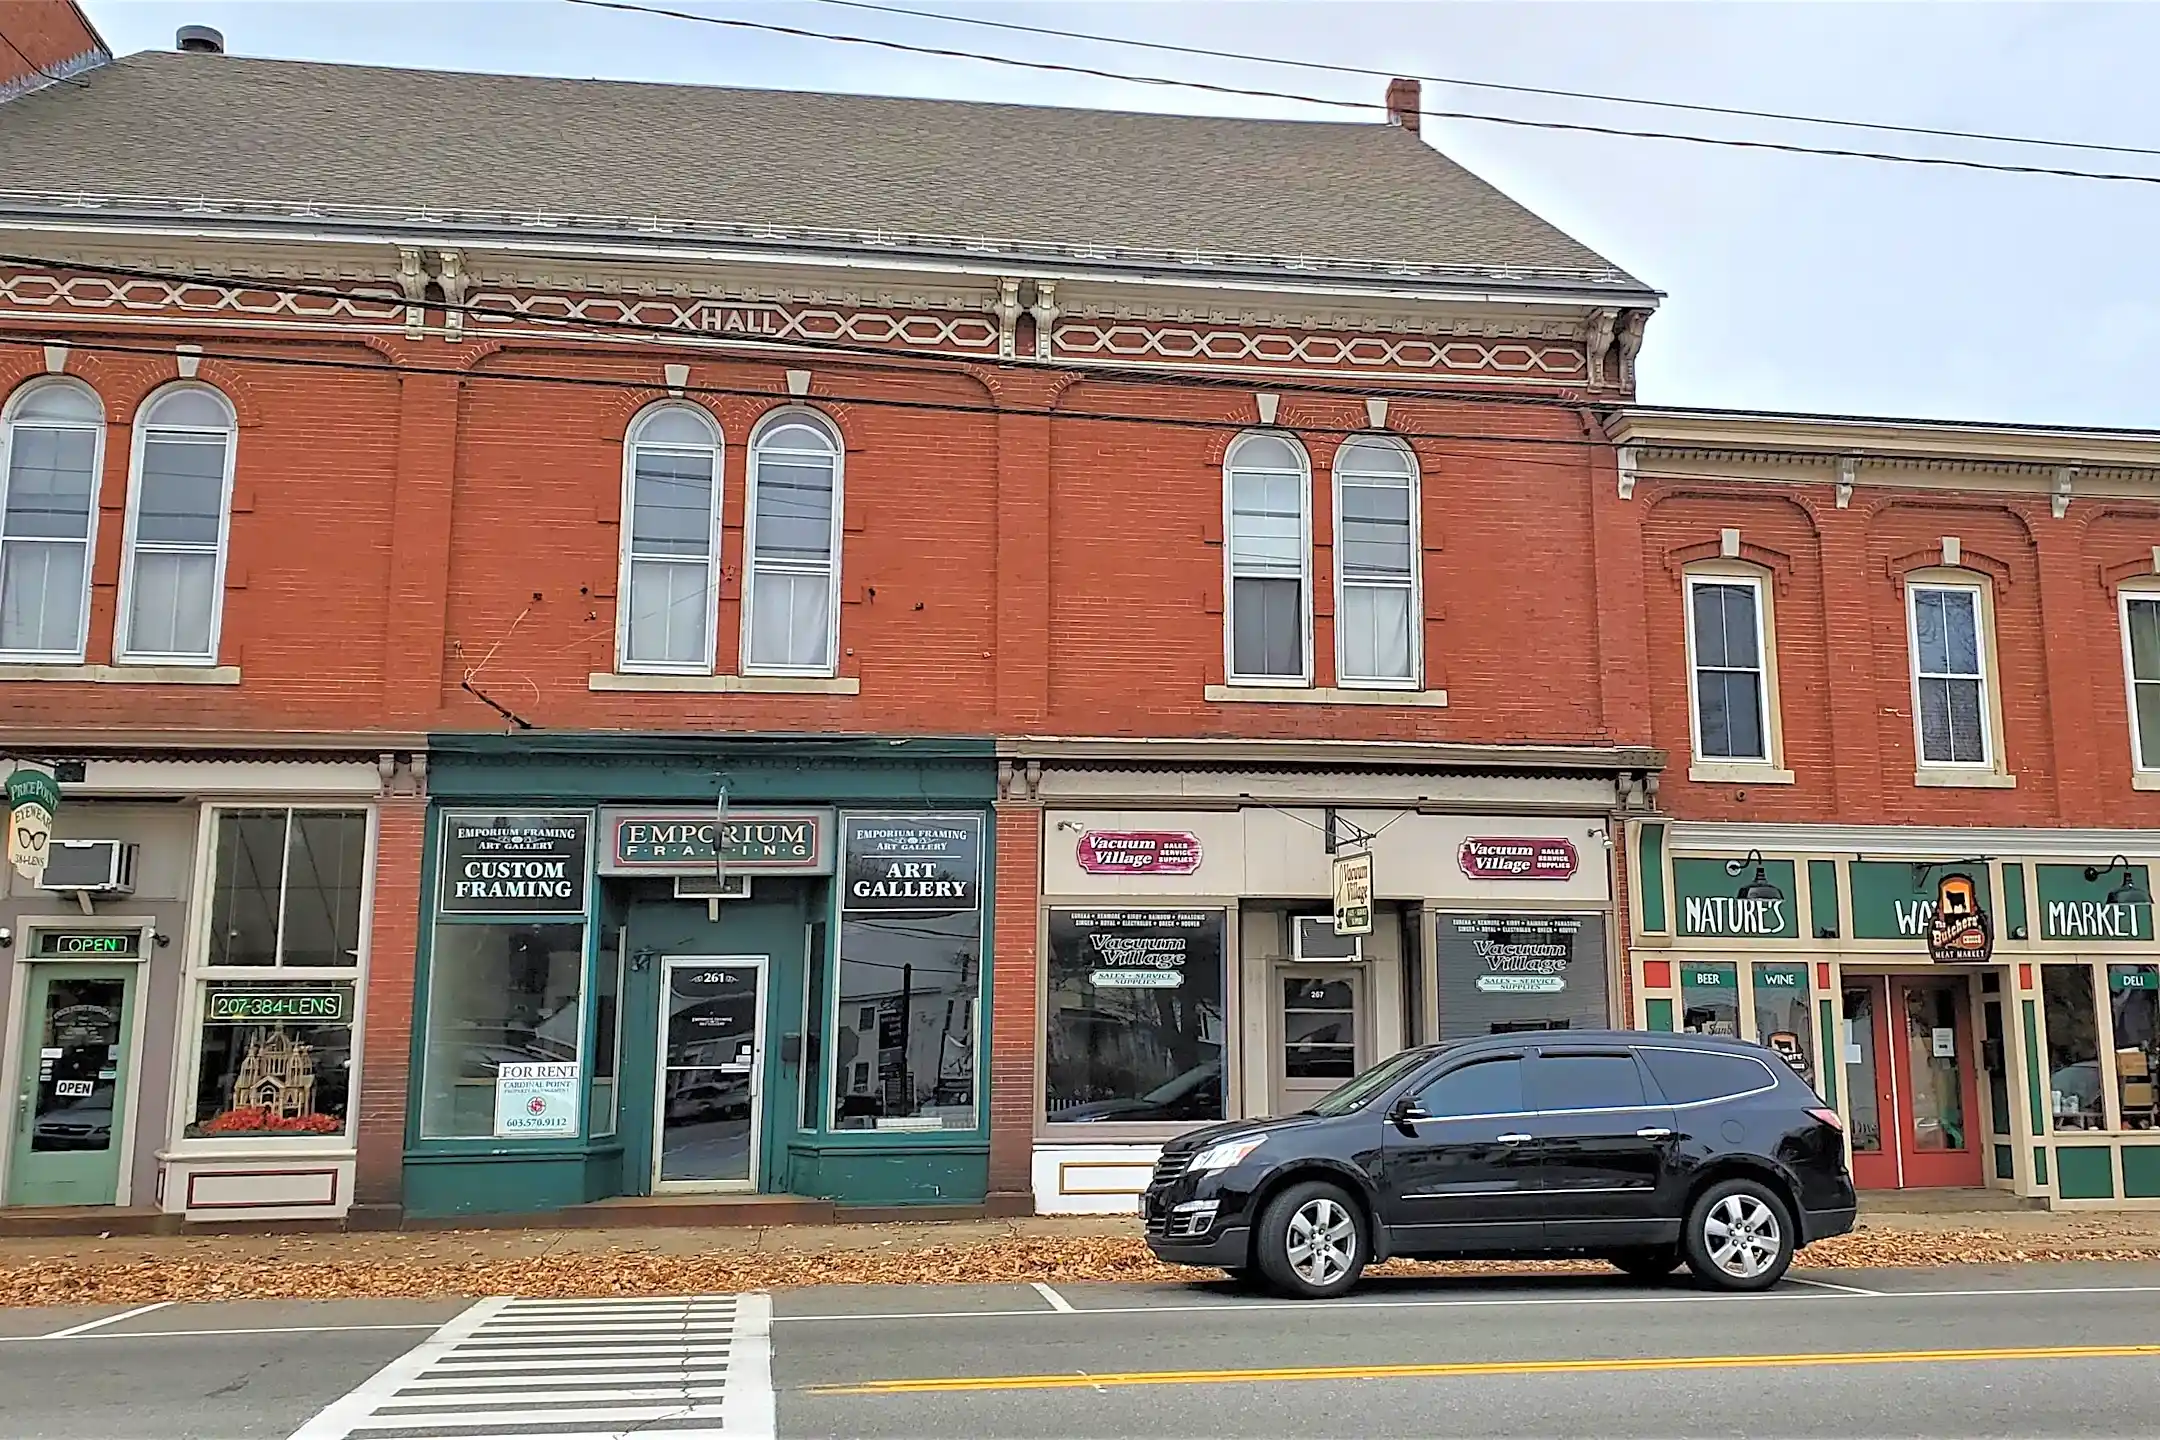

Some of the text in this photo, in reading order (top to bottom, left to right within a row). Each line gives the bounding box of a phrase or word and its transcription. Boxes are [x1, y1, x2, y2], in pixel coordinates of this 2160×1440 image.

[701, 308, 777, 334] HALL
[15, 805, 52, 830] EYEWEAR
[457, 828, 576, 839] EMPORIUM FRAMING
[628, 825, 806, 844] EMPORIUM
[856, 829, 967, 840] EMPORIUM FRAMING
[478, 841, 554, 850] ART GALLERY
[876, 842, 948, 851] ART GALLERY
[1089, 836, 1156, 849] Vacuum
[1469, 842, 1534, 856] Vacuum
[1095, 850, 1153, 868] Village
[1475, 856, 1531, 874] Village
[464, 862, 566, 879] CUSTOM
[886, 862, 937, 878] ART
[1344, 863, 1368, 882] Vacuum
[455, 880, 573, 898] FRAMING
[853, 880, 967, 897] GALLERY
[1347, 881, 1368, 904] Village
[1685, 896, 1786, 934] NATURE'S
[1894, 900, 1938, 935] WA
[2048, 901, 2139, 937] MARKET
[69, 938, 117, 952] OPEN
[1089, 934, 1186, 950] Vacuum
[1473, 940, 1566, 956] Vacuum
[1101, 949, 1186, 970] Village
[1935, 950, 1985, 959] MEAT MARKET
[1485, 955, 1567, 974] Village
[703, 972, 725, 983] 261
[1697, 974, 1721, 985] BEER
[1765, 974, 1795, 985] WINE
[2123, 976, 2144, 986] DELI
[218, 997, 337, 1015] 207-384-LENS
[502, 1066, 578, 1078] FOR RENT
[58, 1082, 91, 1094] OPEN
[504, 1080, 572, 1089] CARDINAL POINT
[506, 1117, 567, 1127] 603.570.9112
